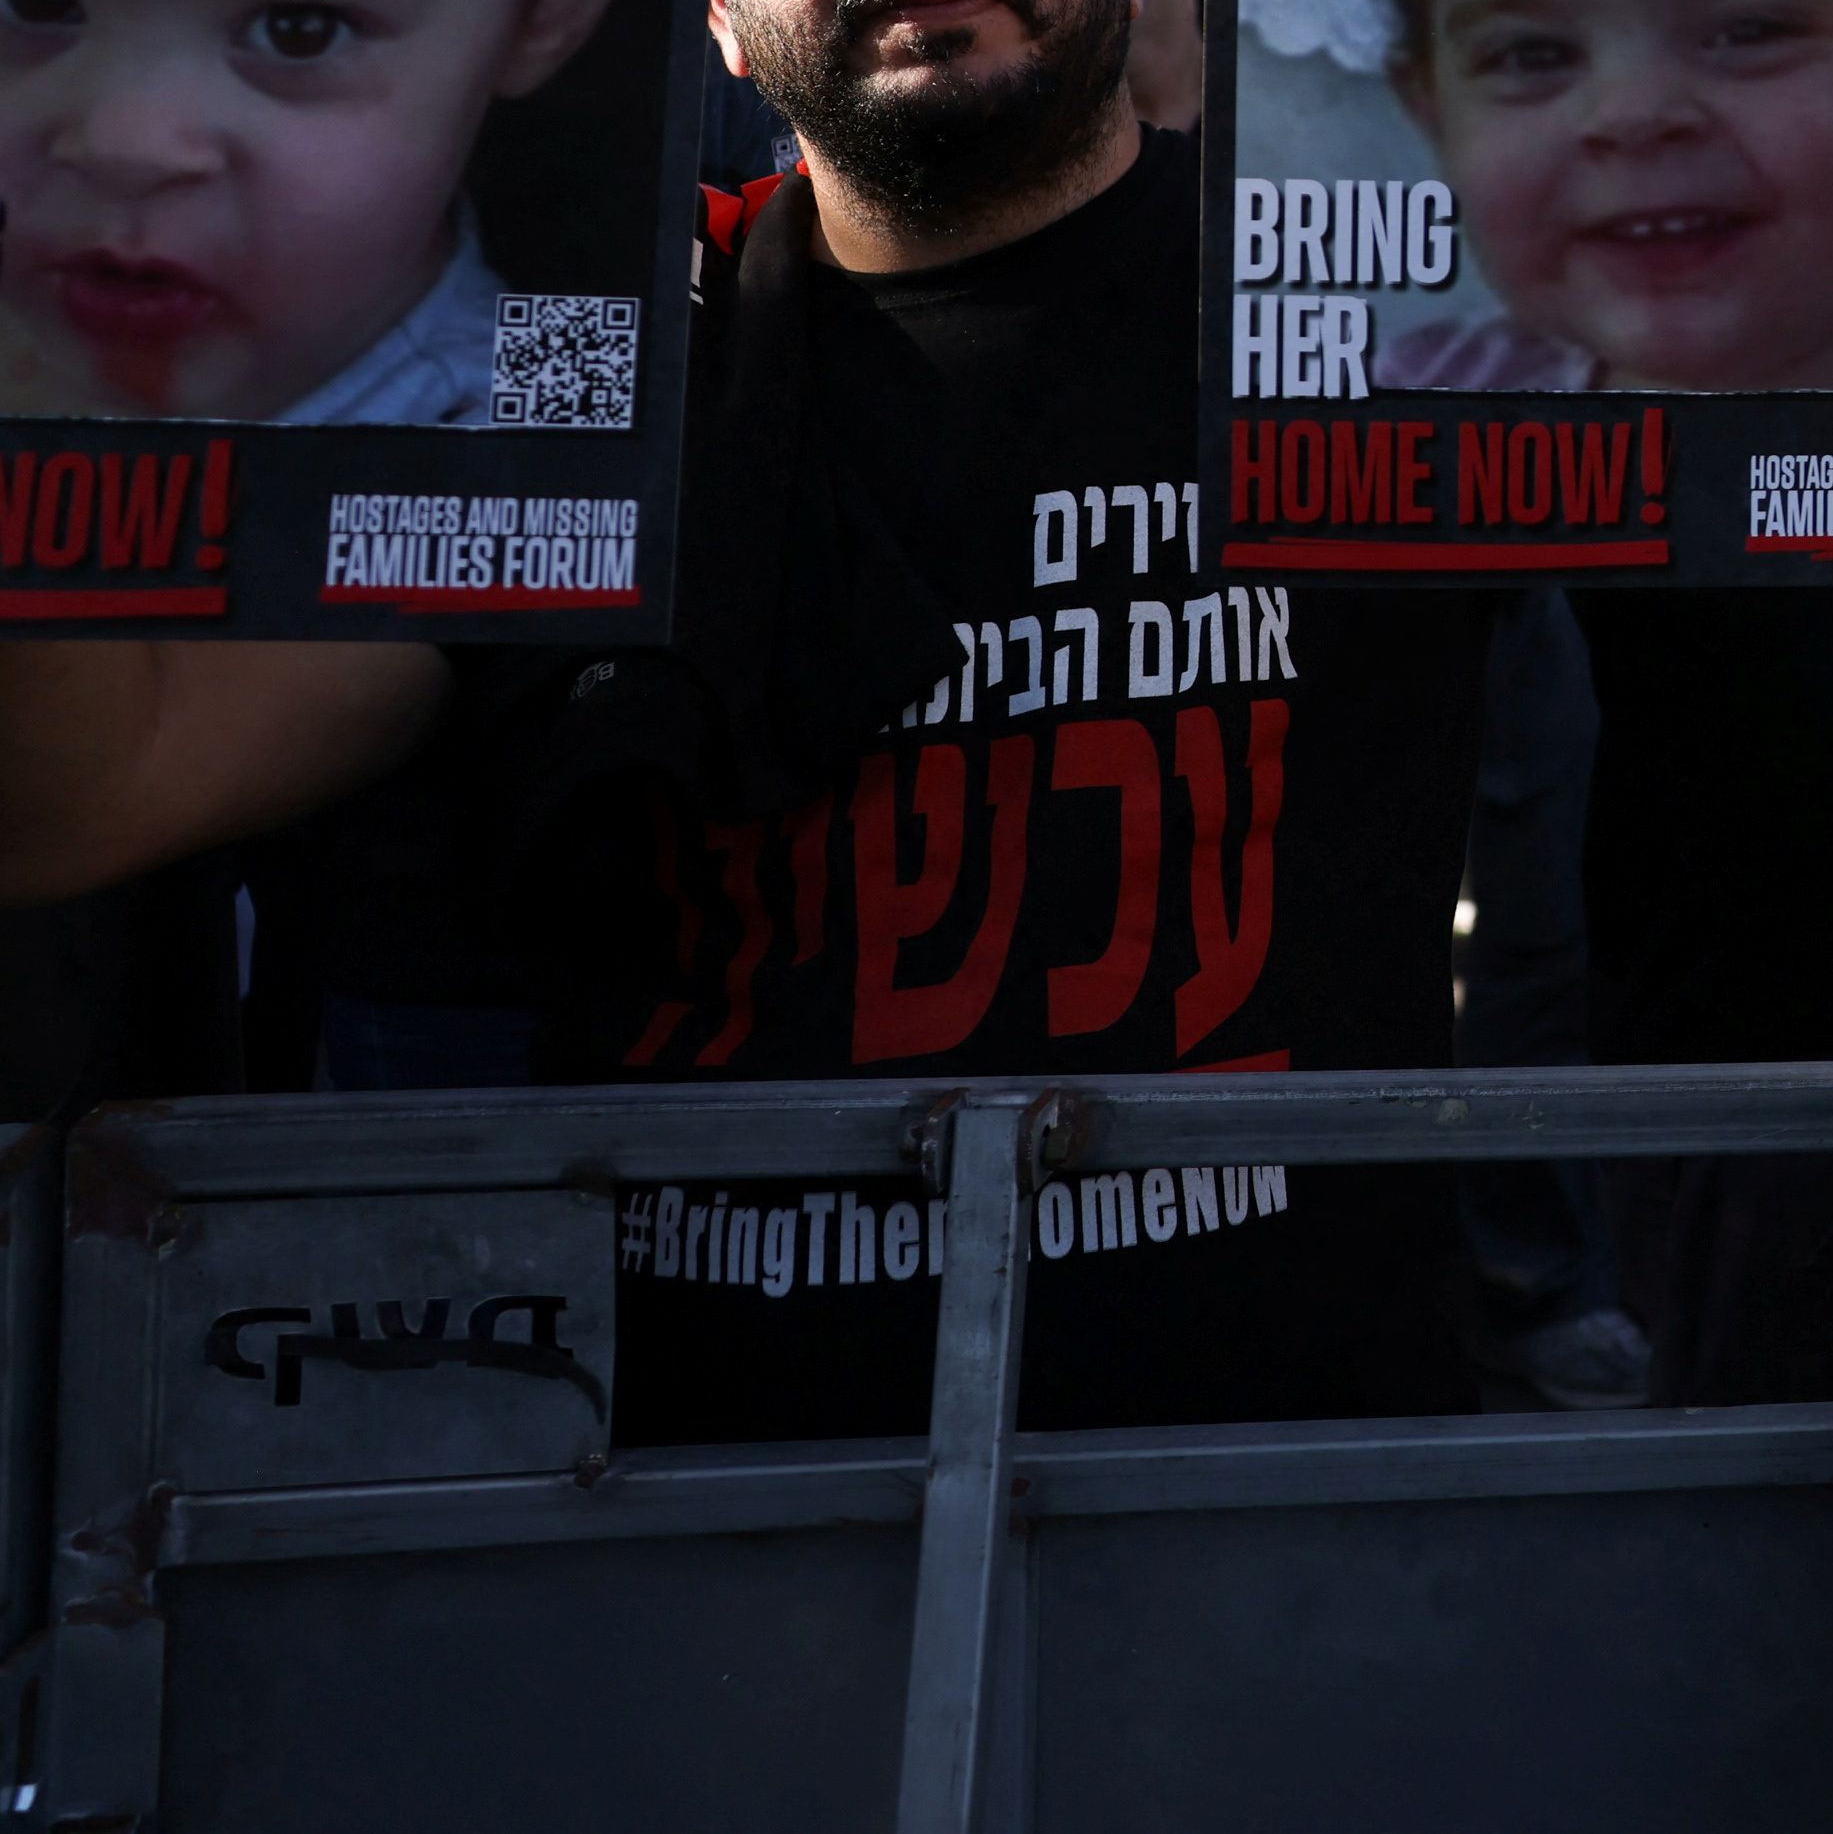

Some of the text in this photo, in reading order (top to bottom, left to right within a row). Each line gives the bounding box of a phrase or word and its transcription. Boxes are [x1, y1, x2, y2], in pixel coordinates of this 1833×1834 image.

[1234, 177, 1453, 285] BRING
[1231, 294, 1370, 399] HER
[330, 494, 639, 538] HOSTAGES AND MISSING
[1230, 407, 1666, 526] HOME NOW!
[325, 533, 636, 591] FAMILIES FORUM
[1127, 586, 1298, 699] אותם
